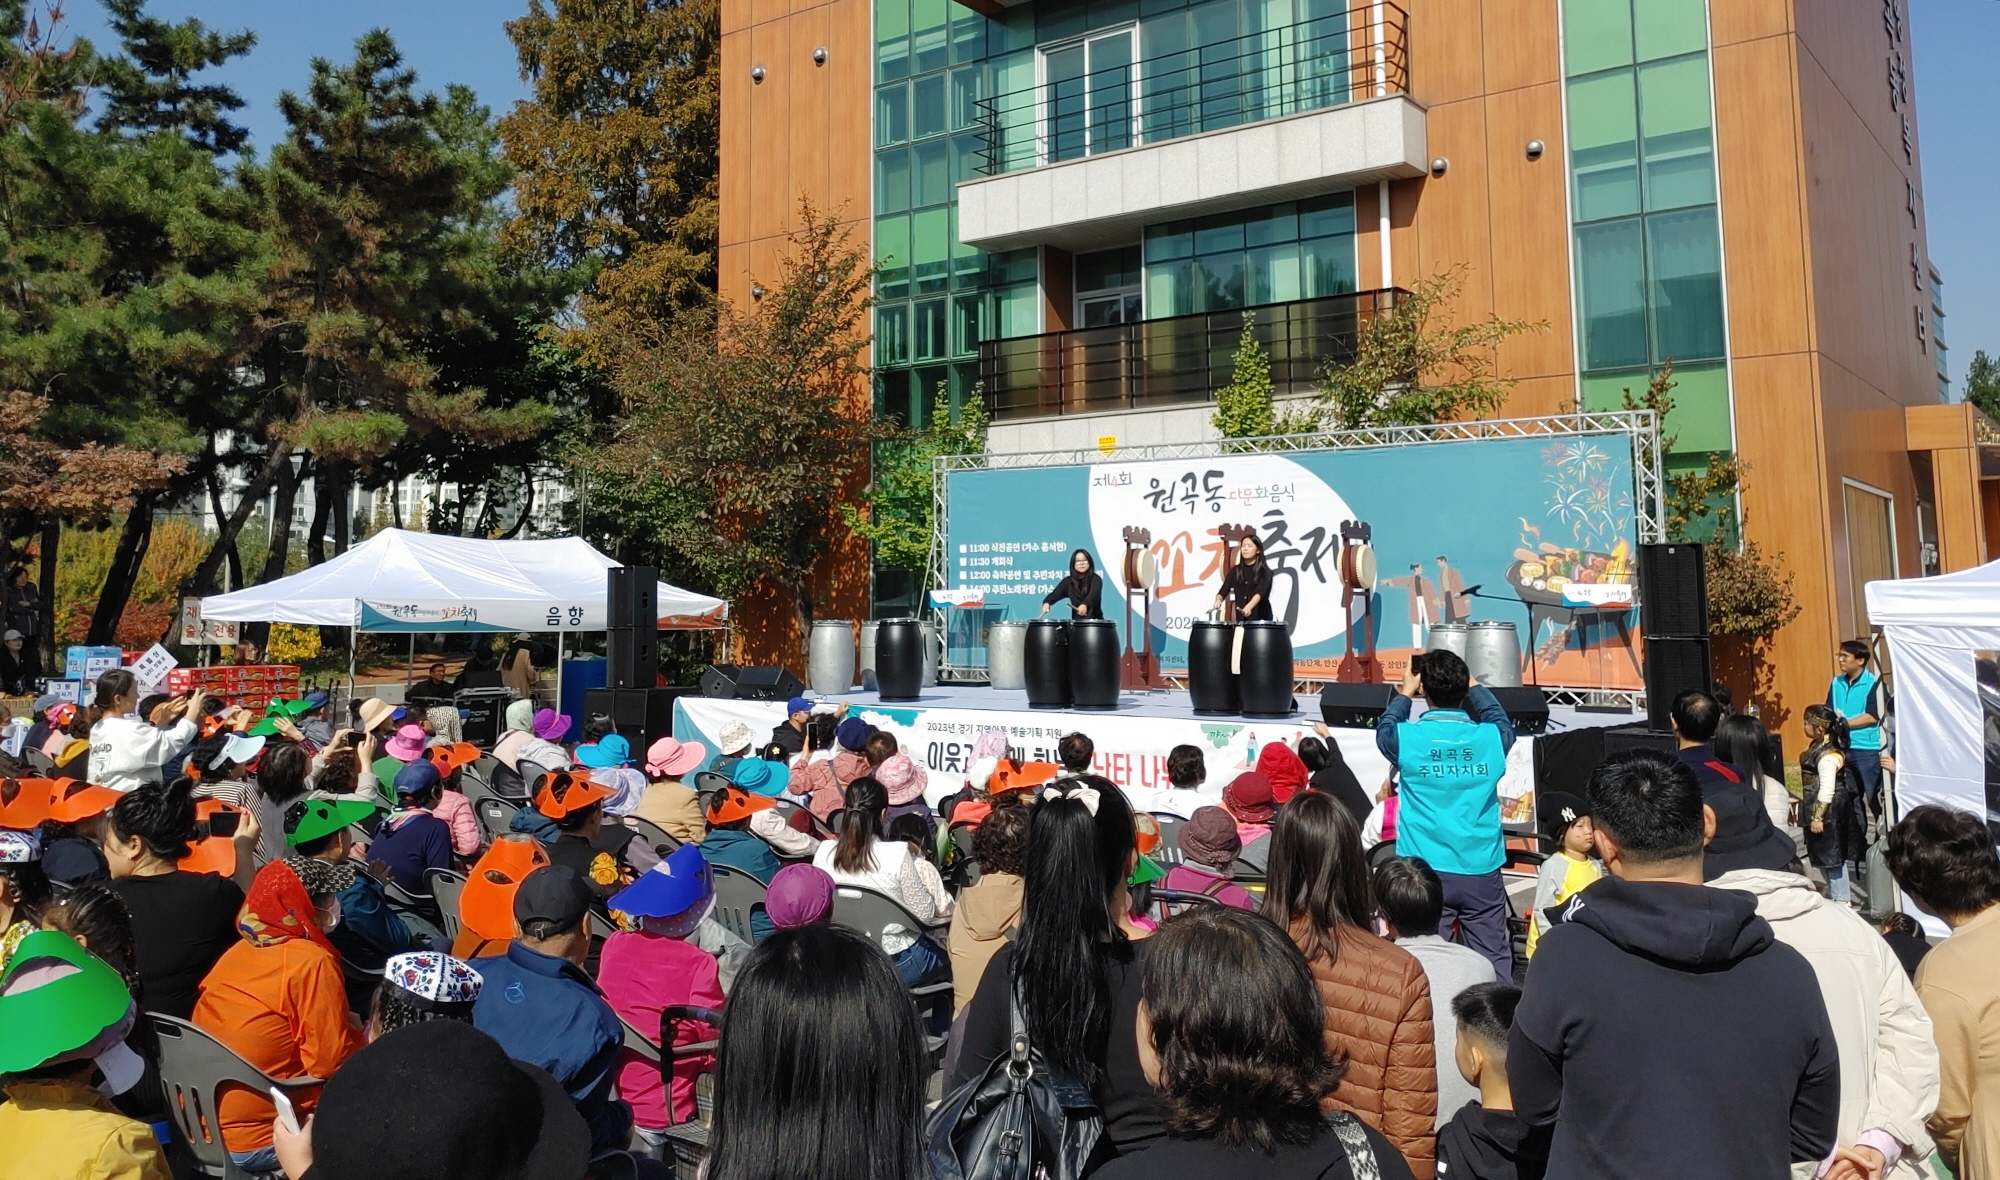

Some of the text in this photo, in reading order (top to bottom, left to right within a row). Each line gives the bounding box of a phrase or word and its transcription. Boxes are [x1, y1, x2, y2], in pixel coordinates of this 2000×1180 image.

[1093, 471, 1132, 487] 제4회
[1143, 470, 1295, 515] 원곡동 다문화음식
[969, 543, 989, 553] 11:00
[969, 557, 989, 566] 11:30
[969, 571, 990, 580] 12:00
[1023, 570, 1031, 580] 및
[1032, 570, 1062, 580] 주민자치
[992, 584, 1036, 595] 주민노래자랑
[442, 605, 478, 626] 꼬치축제
[546, 606, 584, 626] 음향
[926, 722, 956, 735] 2023년
[957, 723, 975, 735] 경기
[1010, 726, 1043, 739] 예술기획
[1045, 728, 1063, 740] 지원
[1430, 748, 1474, 762] 원곡동
[1418, 763, 1490, 779] 주민자치회
[1561, 806, 1577, 823] NY
